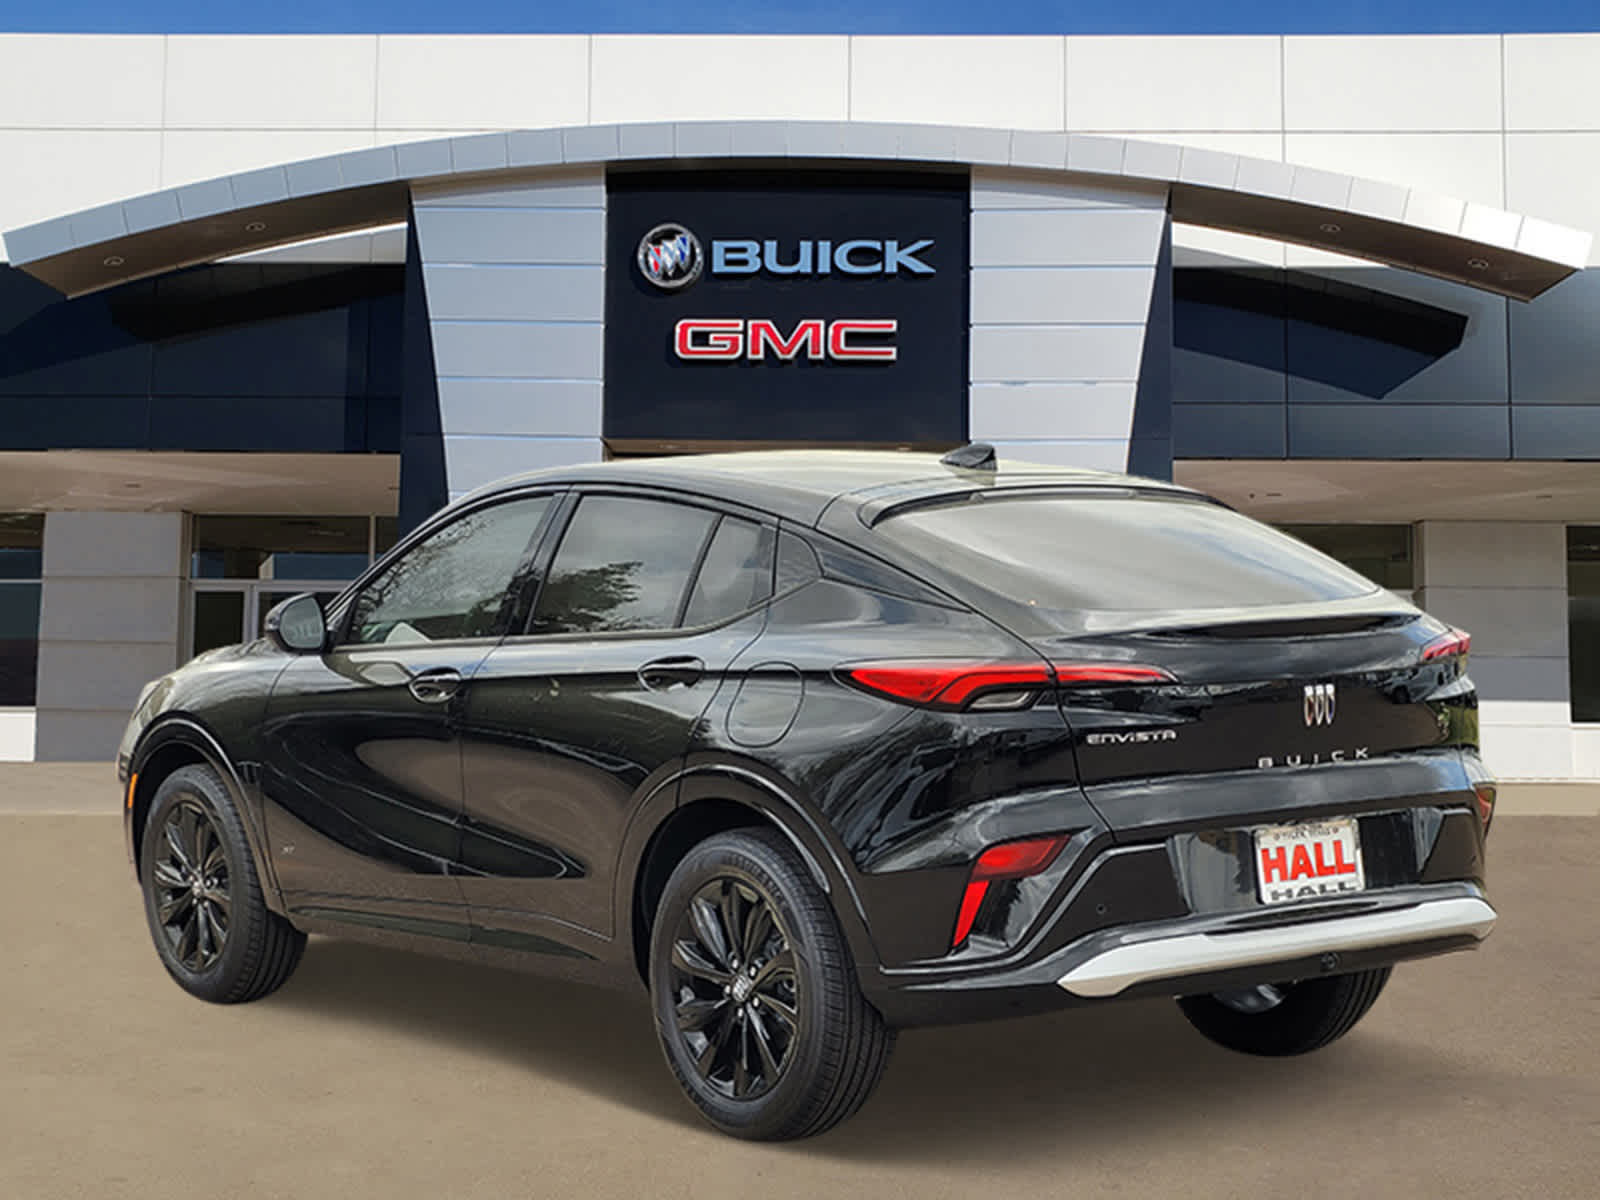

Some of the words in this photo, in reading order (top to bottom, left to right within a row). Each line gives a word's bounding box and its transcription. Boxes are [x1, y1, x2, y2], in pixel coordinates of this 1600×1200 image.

[711, 239, 936, 274] BUICK
[675, 319, 898, 360] GMC
[1087, 730, 1177, 745] ENVISTA
[1258, 747, 1369, 769] BUICK
[1261, 840, 1356, 884] HALL
[1271, 882, 1355, 901] HALL
